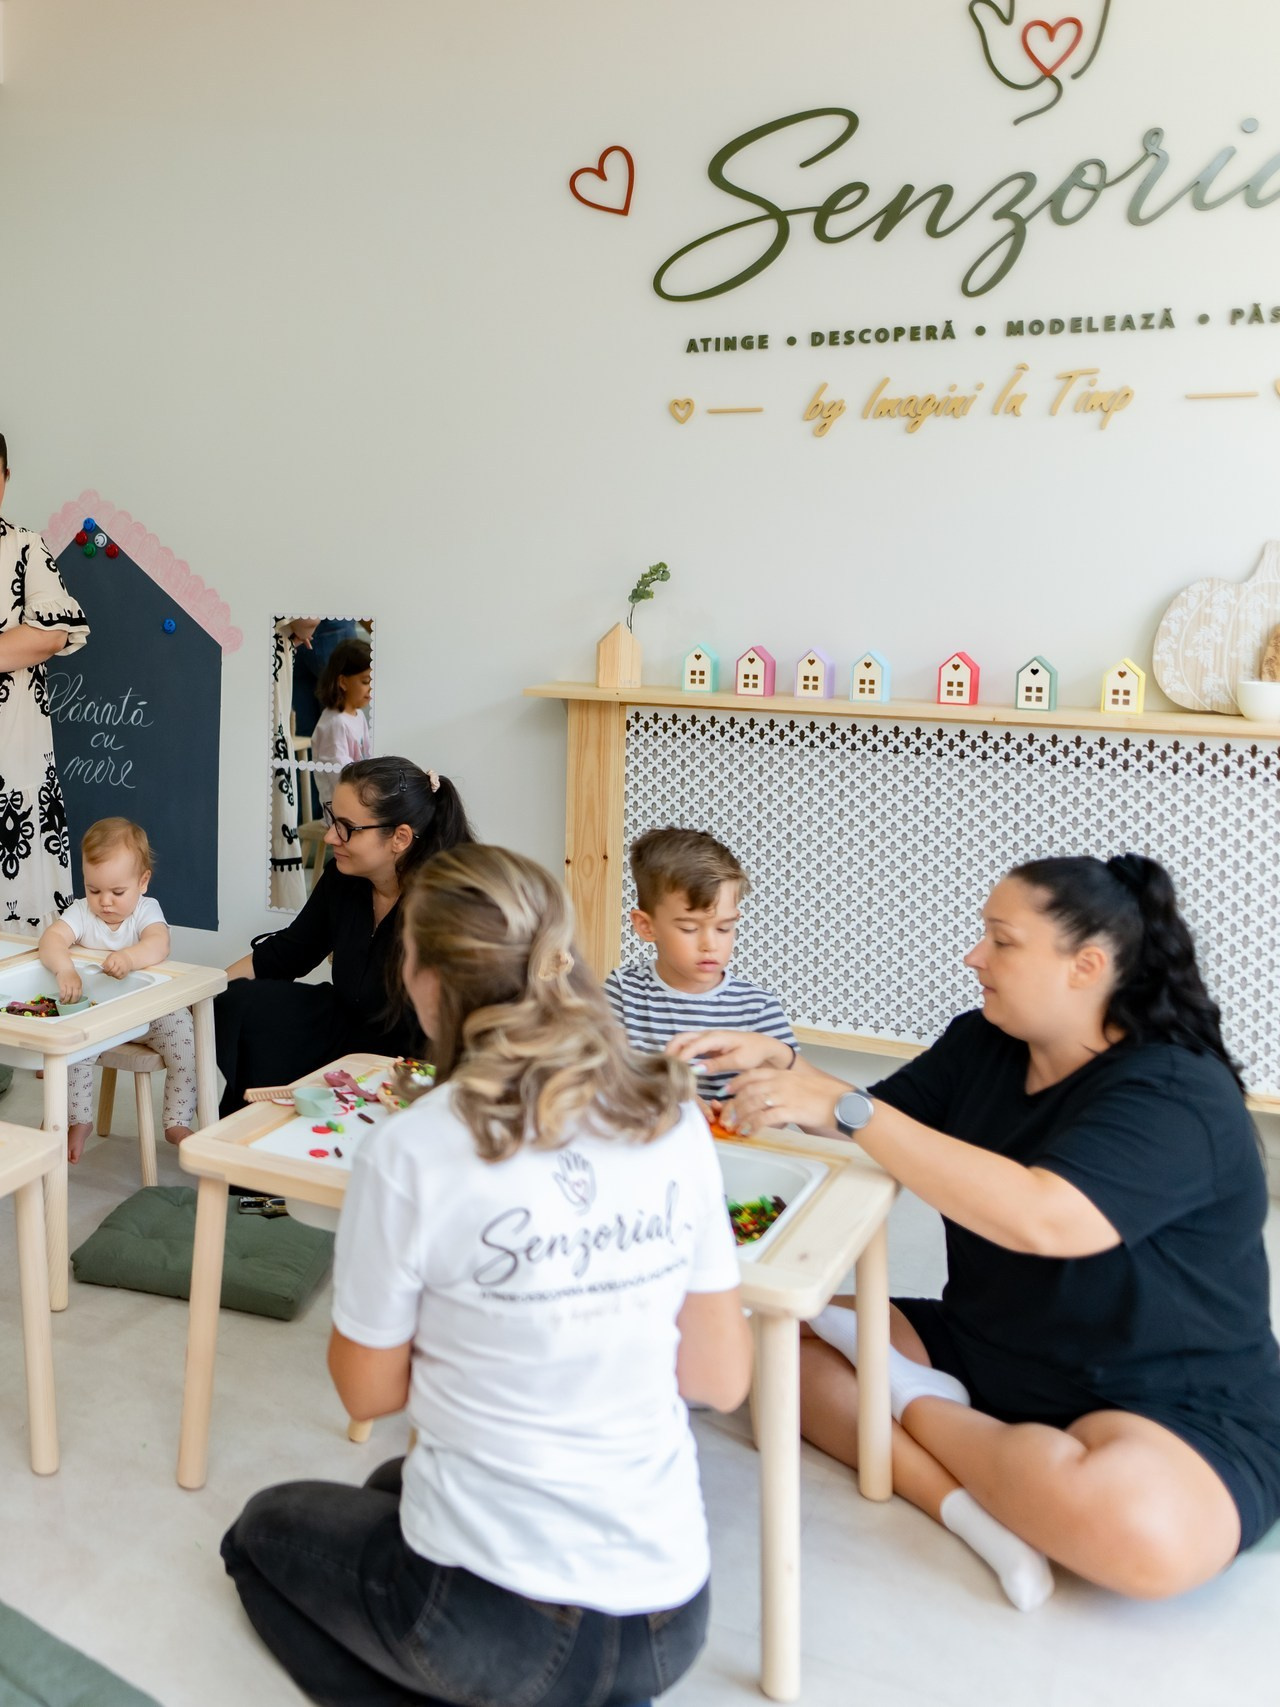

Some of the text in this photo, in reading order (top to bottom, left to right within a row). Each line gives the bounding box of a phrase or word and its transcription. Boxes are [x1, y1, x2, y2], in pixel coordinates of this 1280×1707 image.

[685, 334, 770, 354] ATINGE
[810, 319, 956, 347] DESCOPERĂ
[1006, 307, 1176, 338] MODELEAZĂ
[802, 362, 1135, 438] by Imagini În Timp
[90, 732, 125, 750] cu
[63, 756, 136, 789] mere
[473, 1180, 678, 1287] Senzorial
